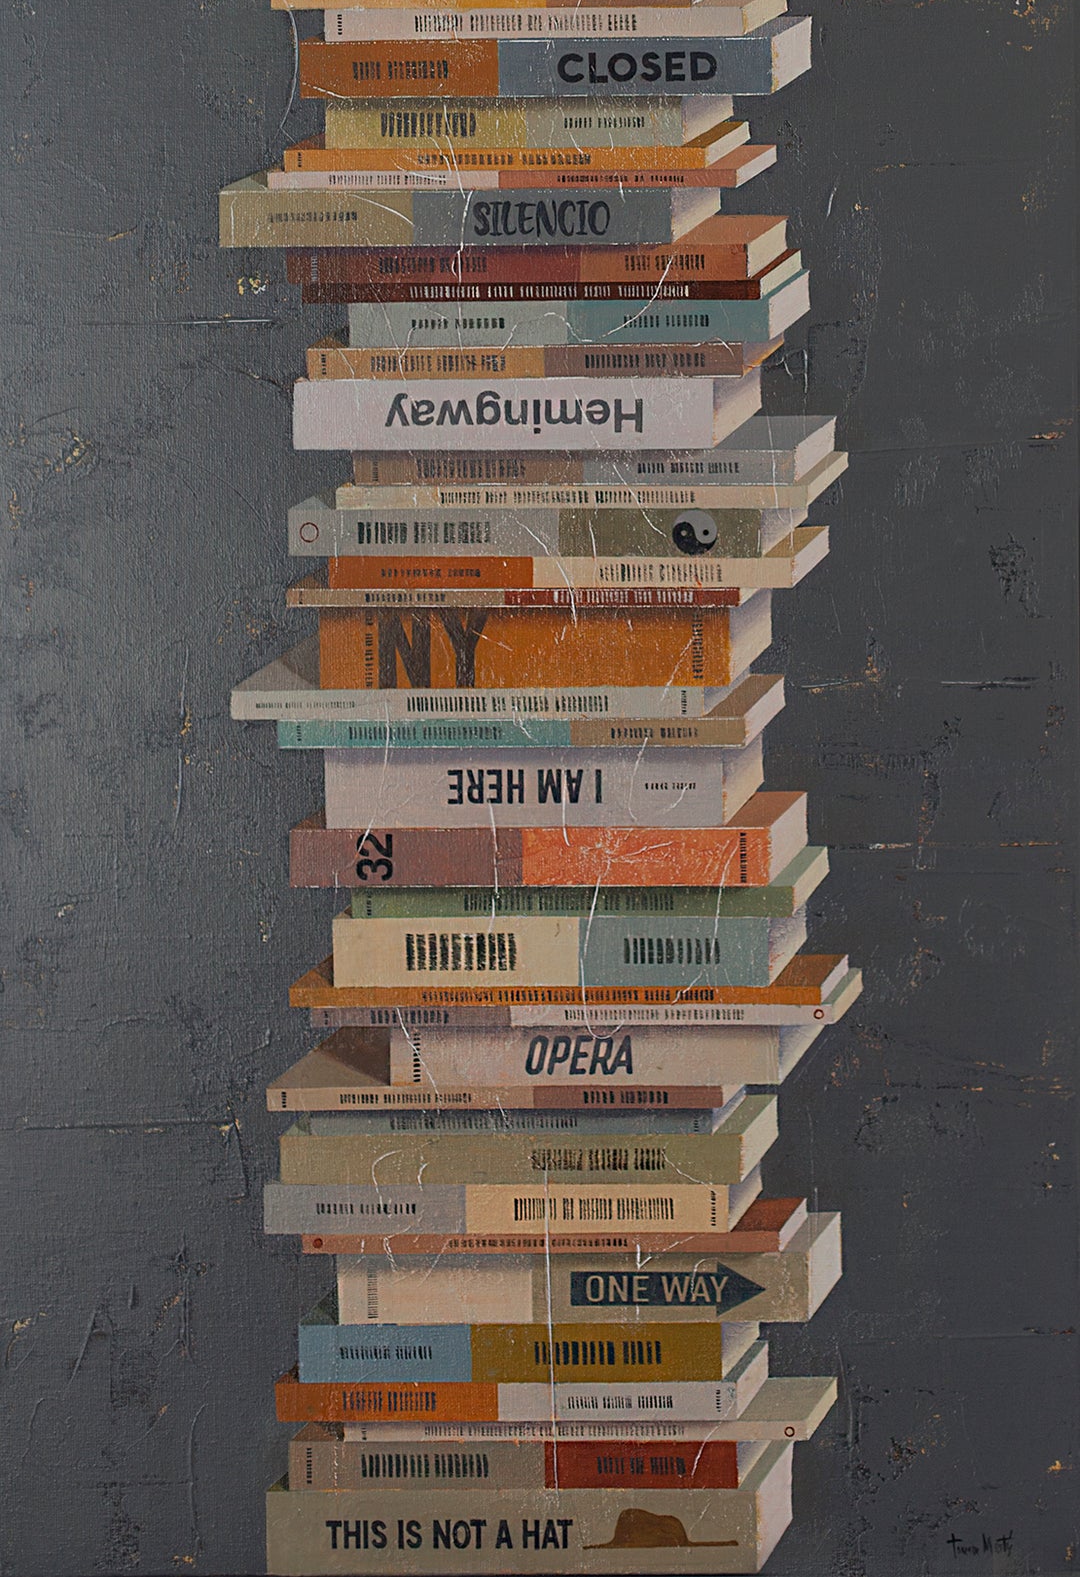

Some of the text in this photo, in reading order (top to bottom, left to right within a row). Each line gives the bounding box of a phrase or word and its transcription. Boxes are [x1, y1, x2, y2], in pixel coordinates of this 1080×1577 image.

[557, 50, 718, 84] CLOSED
[473, 199, 611, 238] SILENCIO
[385, 391, 644, 436] Hemingway
[379, 607, 490, 689] NY
[447, 768, 603, 806] I AM HERE
[357, 832, 393, 882] 32
[525, 1034, 633, 1076] OPERA
[586, 1275, 729, 1303] ONE WAY
[326, 1520, 573, 1550] THIS IS NOT A HAT
